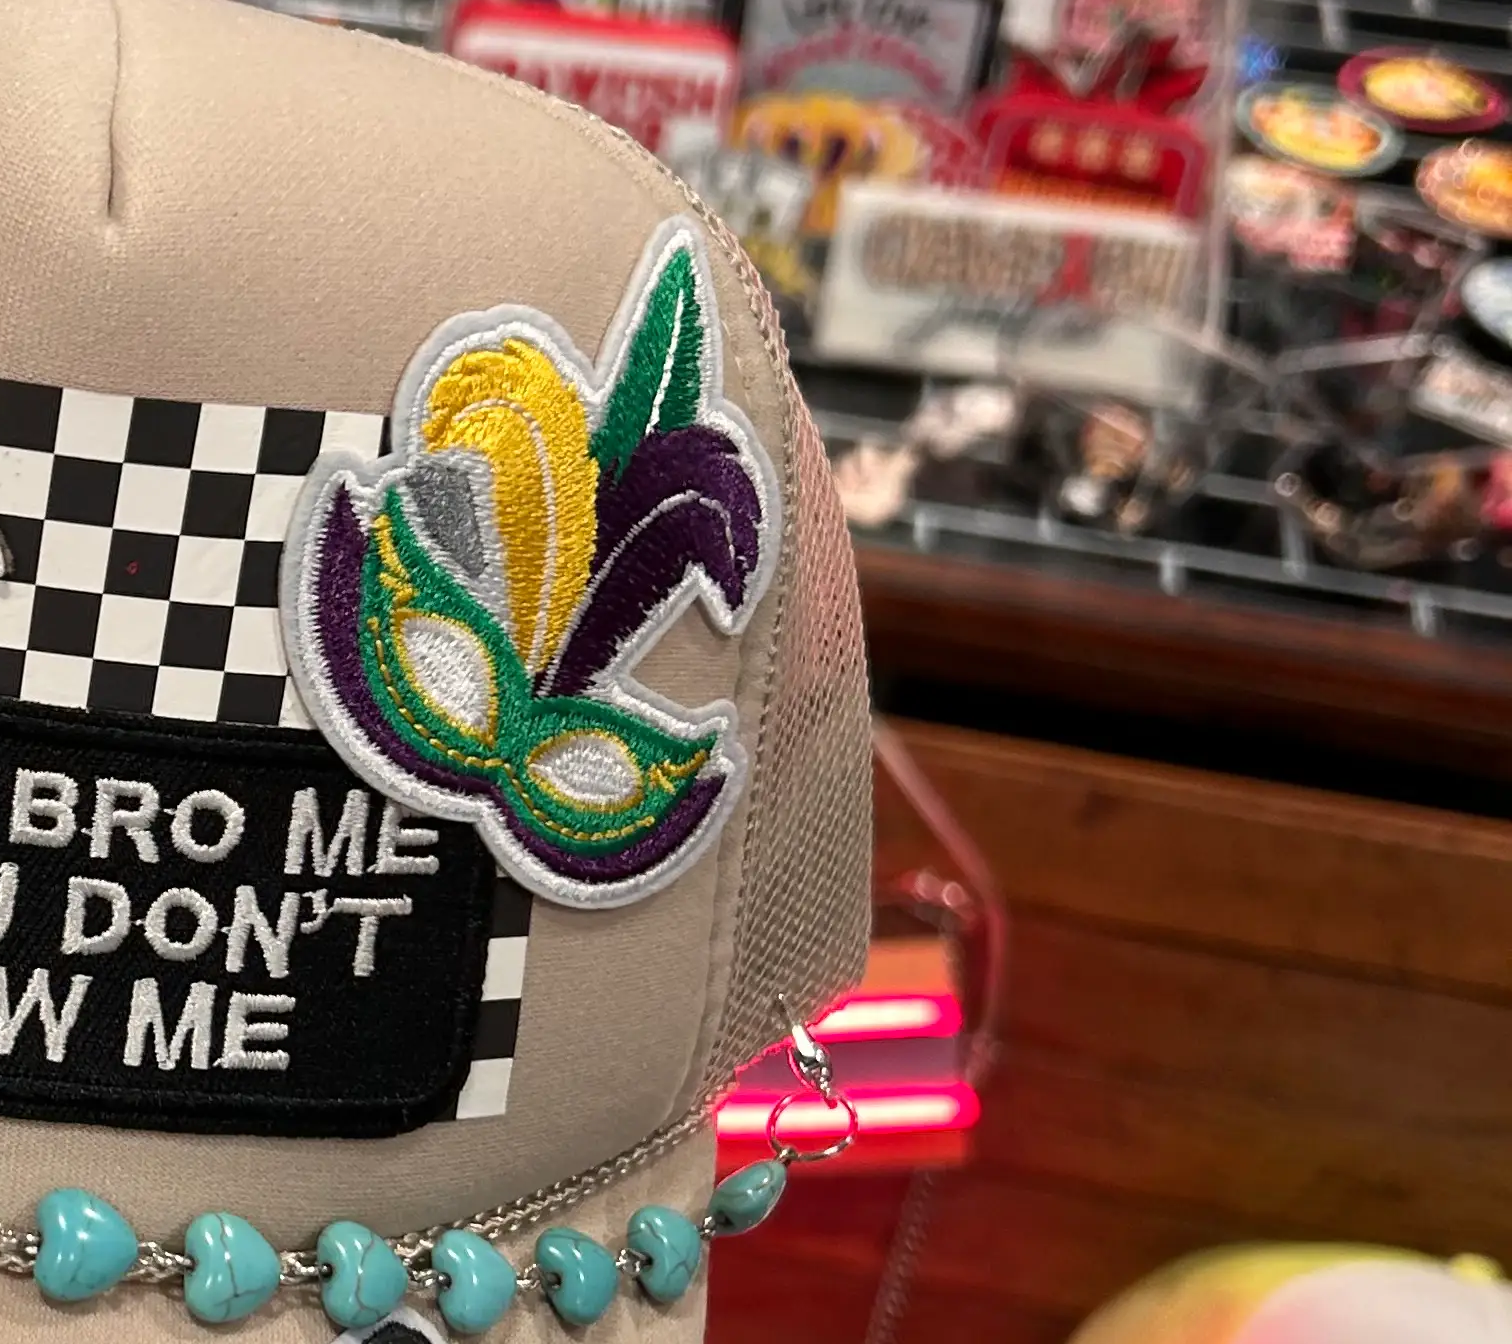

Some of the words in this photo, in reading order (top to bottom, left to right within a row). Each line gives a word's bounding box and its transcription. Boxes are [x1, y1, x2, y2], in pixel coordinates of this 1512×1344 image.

[8, 767, 245, 864] BRO
[284, 786, 440, 877] ME
[61, 876, 413, 978] DON'T
[122, 978, 297, 1072] ME
